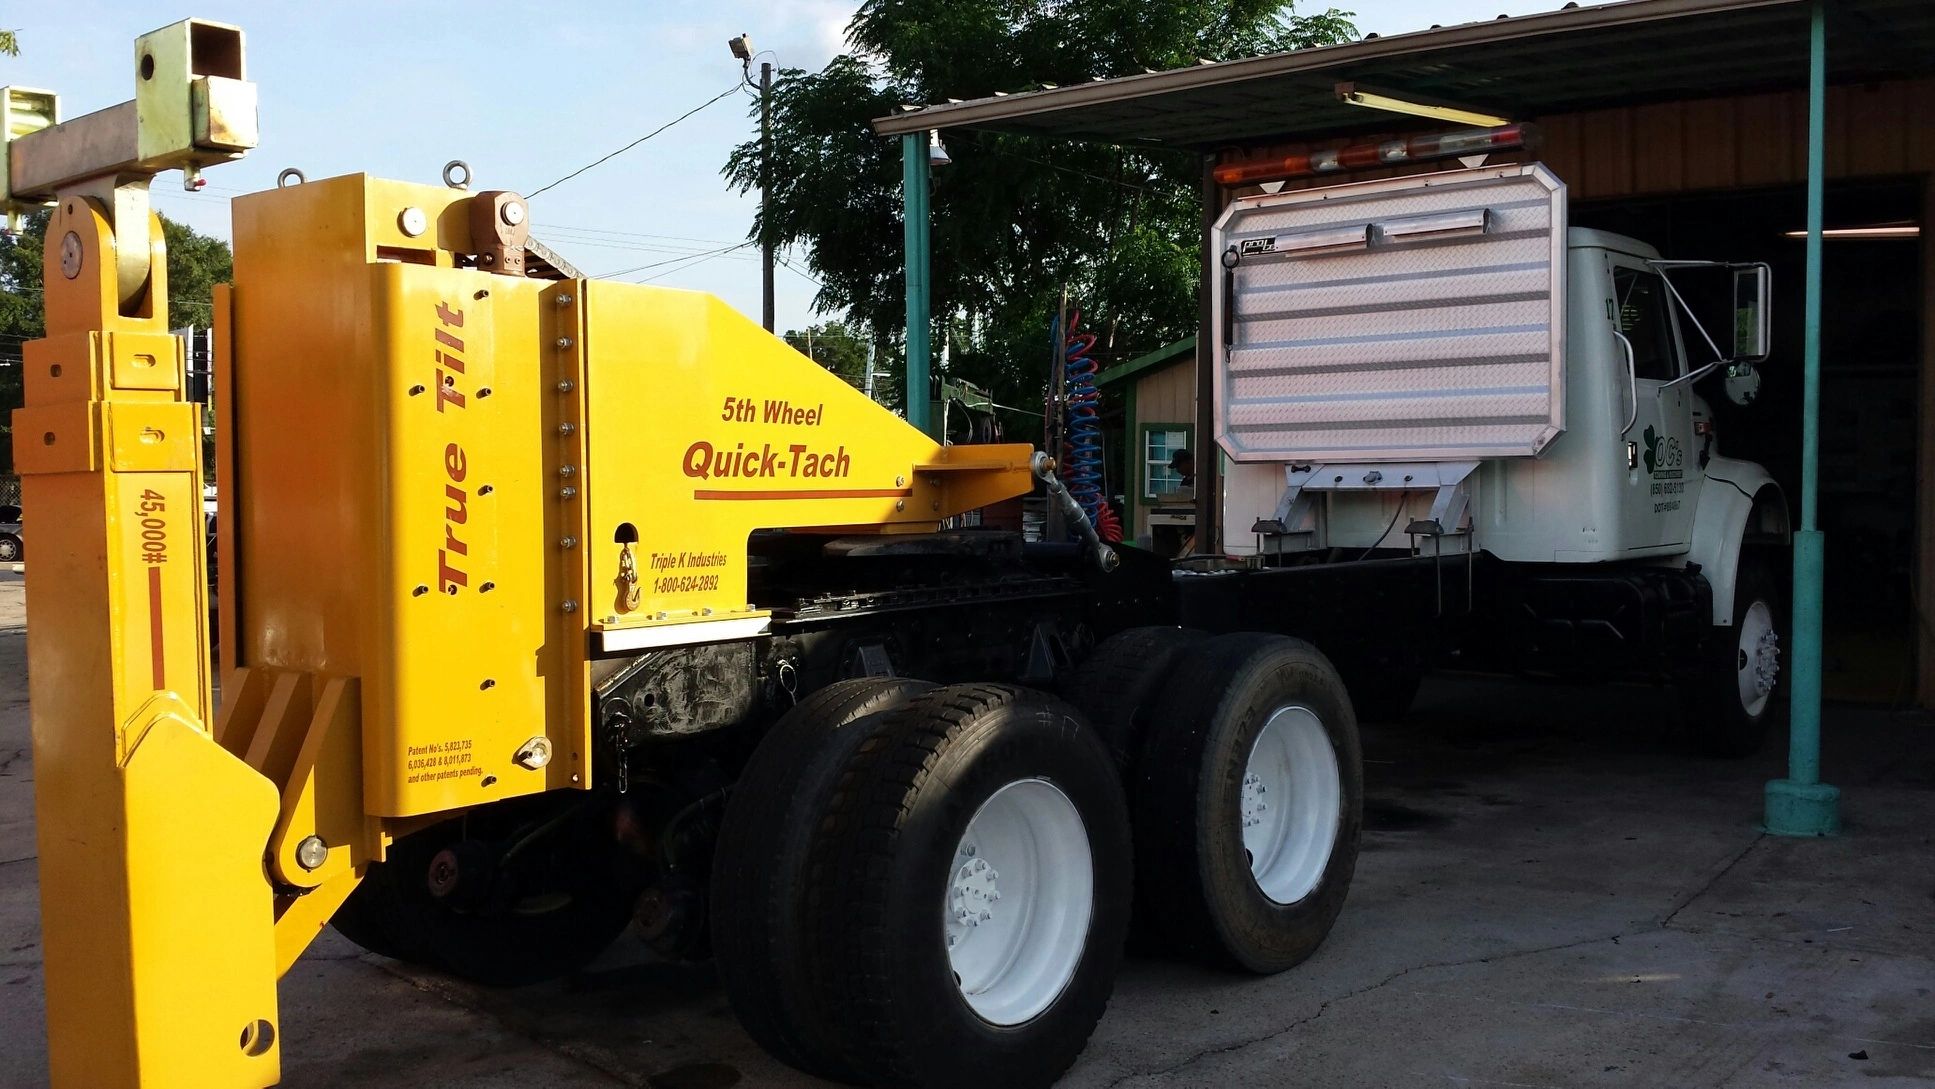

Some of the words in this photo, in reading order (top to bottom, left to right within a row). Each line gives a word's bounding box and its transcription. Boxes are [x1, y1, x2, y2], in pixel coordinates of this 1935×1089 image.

[1605, 297, 1614, 321] 17
[435, 300, 466, 414] Tilt
[721, 397, 756, 423] 5th
[763, 400, 824, 426] Wheel
[682, 441, 850, 481] Quick-Tach
[134, 488, 168, 564] 45,000#
[438, 442, 468, 594] True
[650, 553, 676, 573] Triple
[678, 552, 687, 568] K
[687, 551, 728, 568] Industries
[653, 574, 719, 594] 1-800-624-2892
[408, 746, 428, 756] Patent
[428, 744, 443, 753] No's.
[444, 739, 472, 753] 5,823,735
[408, 757, 437, 771] 6,036,428
[438, 756, 443, 766] &
[443, 753, 472, 767] 8,011,873
[408, 773, 420, 784] and
[420, 771, 436, 782] other
[437, 769, 459, 782] patents
[459, 766, 483, 779] pending.
